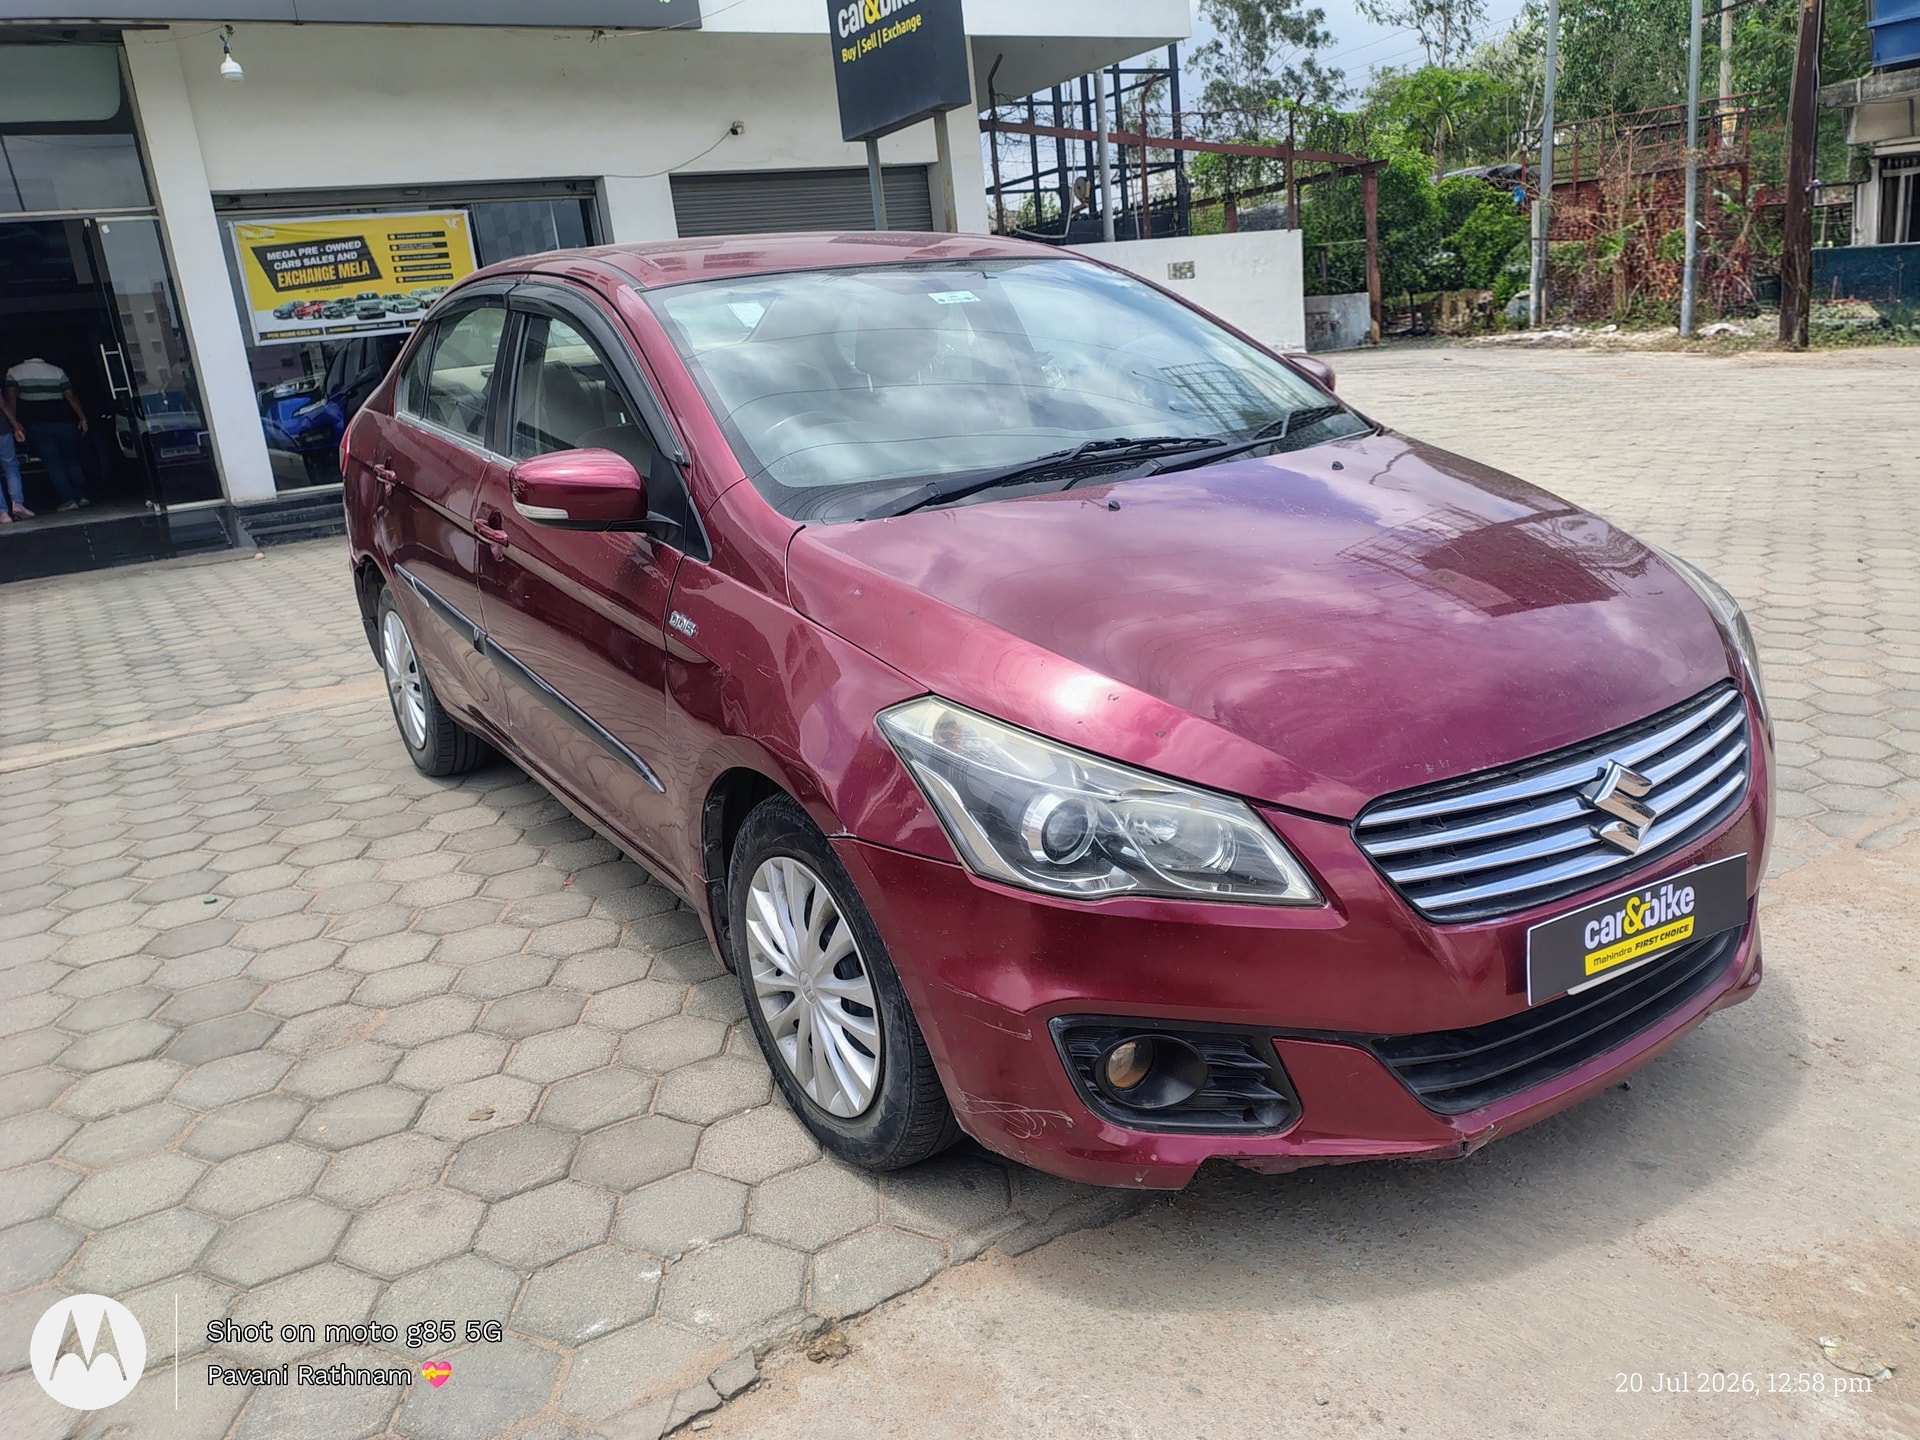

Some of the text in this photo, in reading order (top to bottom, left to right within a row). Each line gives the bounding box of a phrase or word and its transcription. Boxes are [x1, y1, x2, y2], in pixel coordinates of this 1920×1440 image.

[837, 0, 917, 38] car&
[841, 46, 857, 63] Buy
[861, 31, 878, 53] Sell
[882, 14, 922, 43] Exchange
[266, 250, 297, 261] MEGA
[298, 246, 319, 256] PRE
[325, 240, 362, 253] OWNED
[273, 251, 358, 271] CARS SALES AND
[276, 260, 371, 288] EXCHANGE MELA
[1584, 883, 1695, 950] car&bike
[1593, 924, 1690, 967] Mahindra FIRST CHOICE
